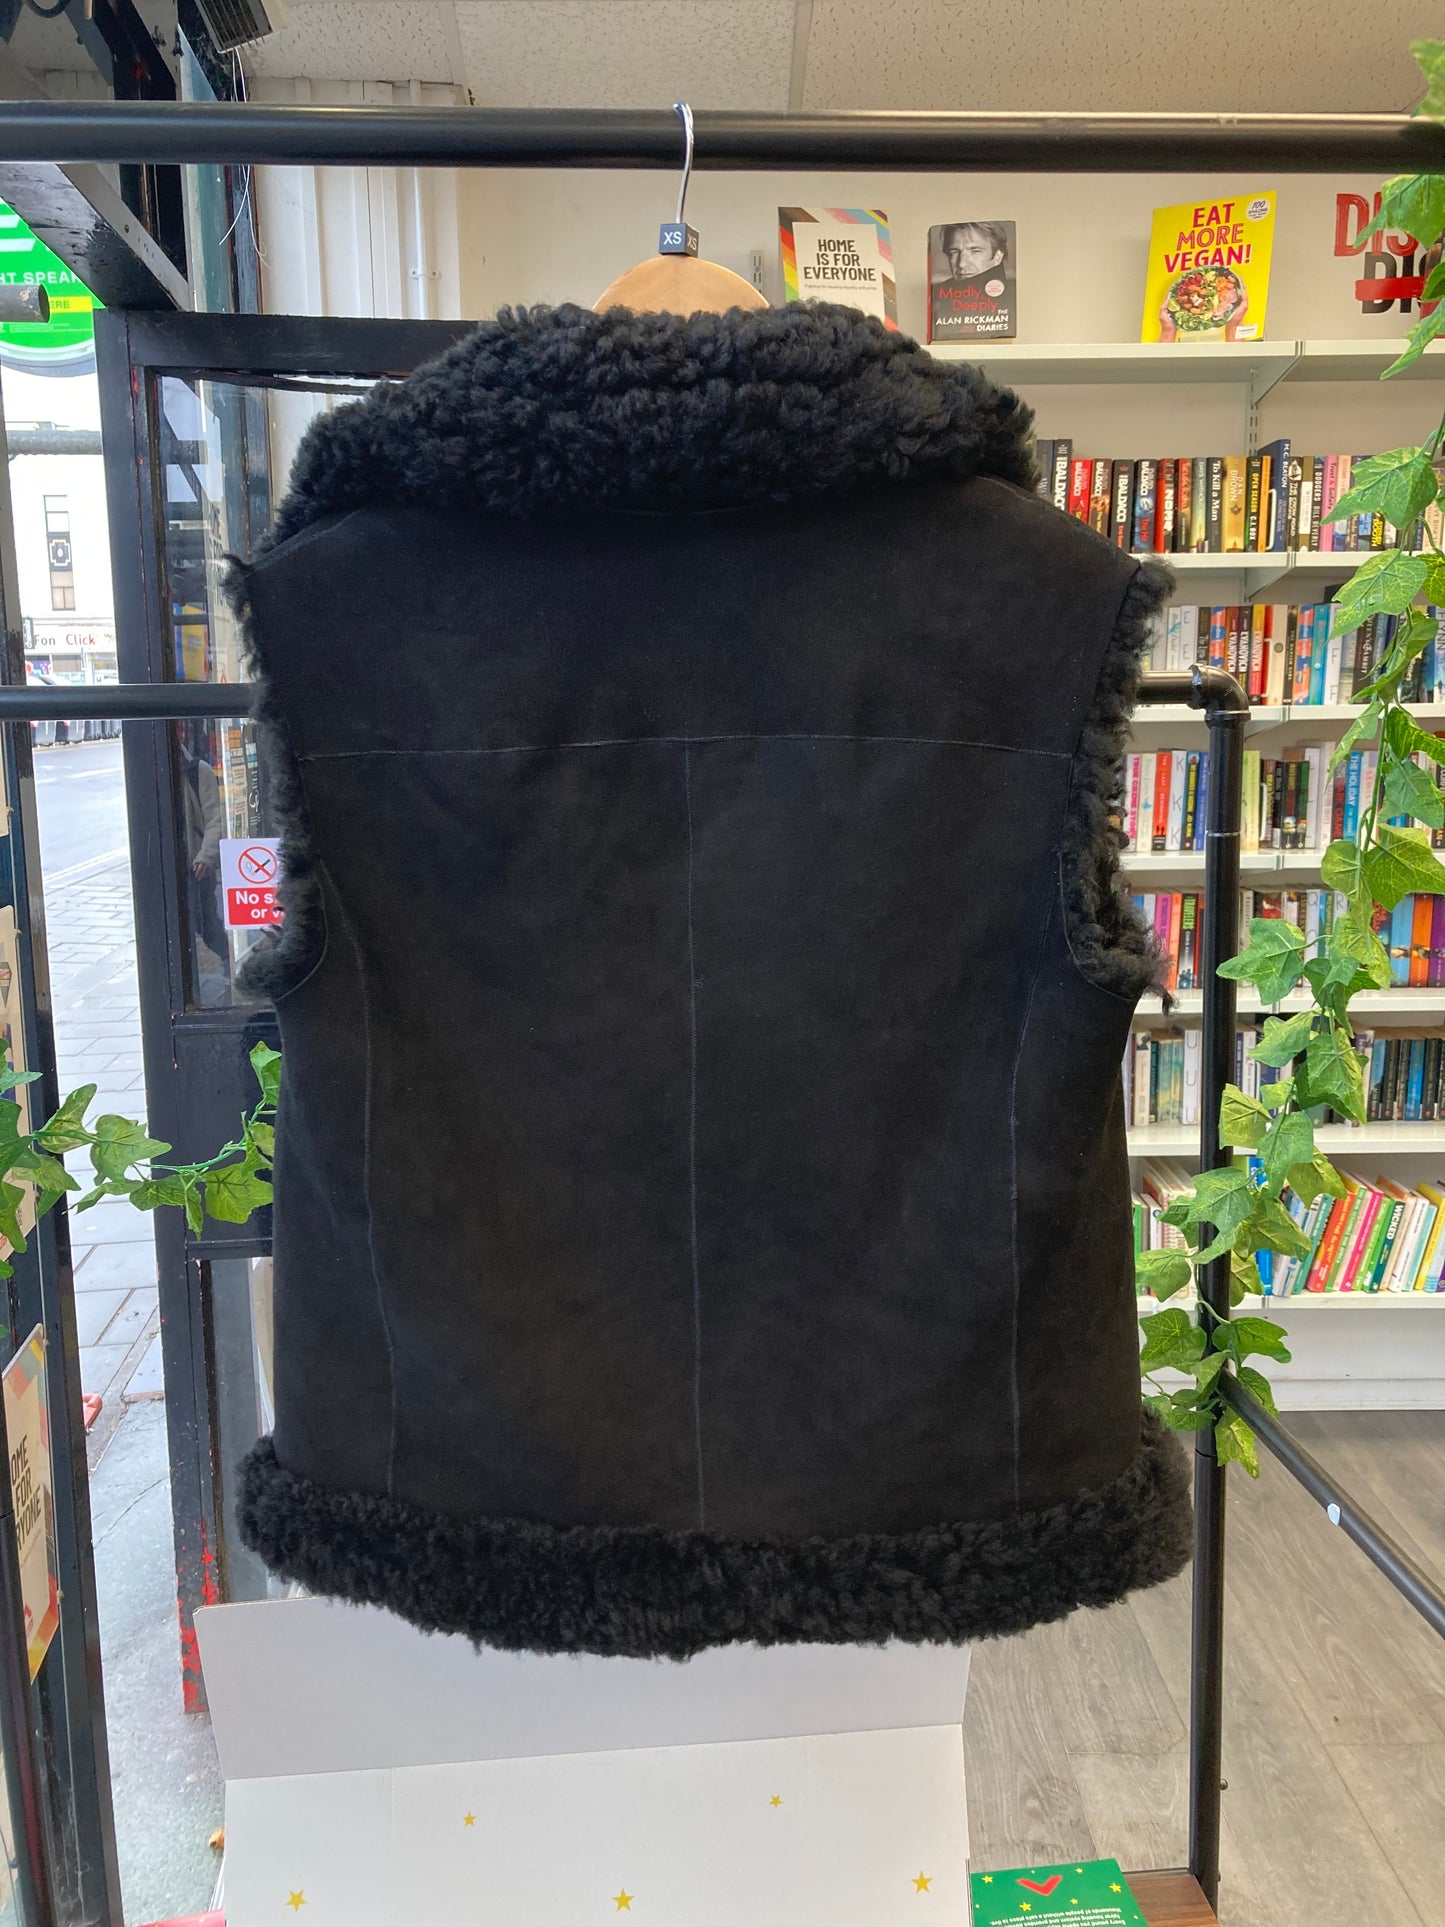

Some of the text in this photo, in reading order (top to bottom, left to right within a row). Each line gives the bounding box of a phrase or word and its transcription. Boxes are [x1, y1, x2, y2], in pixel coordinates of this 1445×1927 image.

[1192, 202, 1235, 228] EAT
[1252, 200, 1266, 209] 100
[663, 230, 682, 245] XS
[687, 234, 697, 251] XS
[818, 239, 856, 252] HOME
[1176, 222, 1244, 251] MORE
[816, 253, 861, 266] IS FOR
[1164, 244, 1251, 273] VEGAN!
[804, 266, 877, 282] EVERYONE
[939, 285, 984, 299] Madly,
[952, 297, 998, 312] Deeply
[936, 315, 1008, 325] ALAN RICKMAN
[976, 324, 1008, 332] DIARIES
[1212, 460, 1220, 473] To
[1074, 462, 1083, 496] BALDACCI
[1095, 462, 1104, 496] BALDACCI
[1140, 462, 1149, 496] BALDACCI
[1212, 474, 1220, 490] Kill
[1230, 470, 1238, 501] BROWN
[1314, 472, 1322, 502] DODGERS
[1116, 478, 1128, 522] BALDACCI
[1212, 499, 1220, 521] Man
[34, 634, 96, 646] Fon Click
[1228, 632, 1237, 672] EVANOVICH
[1238, 631, 1248, 672] EVANOVICH
[1252, 630, 1263, 671] EVANOVICH
[1350, 755, 1358, 770] THE
[1348, 772, 1357, 806] HOLIDAY
[235, 891, 259, 905] No
[251, 908, 267, 919] or
[1183, 899, 1195, 930] TRAVELERS
[1386, 1204, 1404, 1240] WICKED
[11, 1433, 28, 1486] OME
[16, 1467, 32, 1518] FOR
